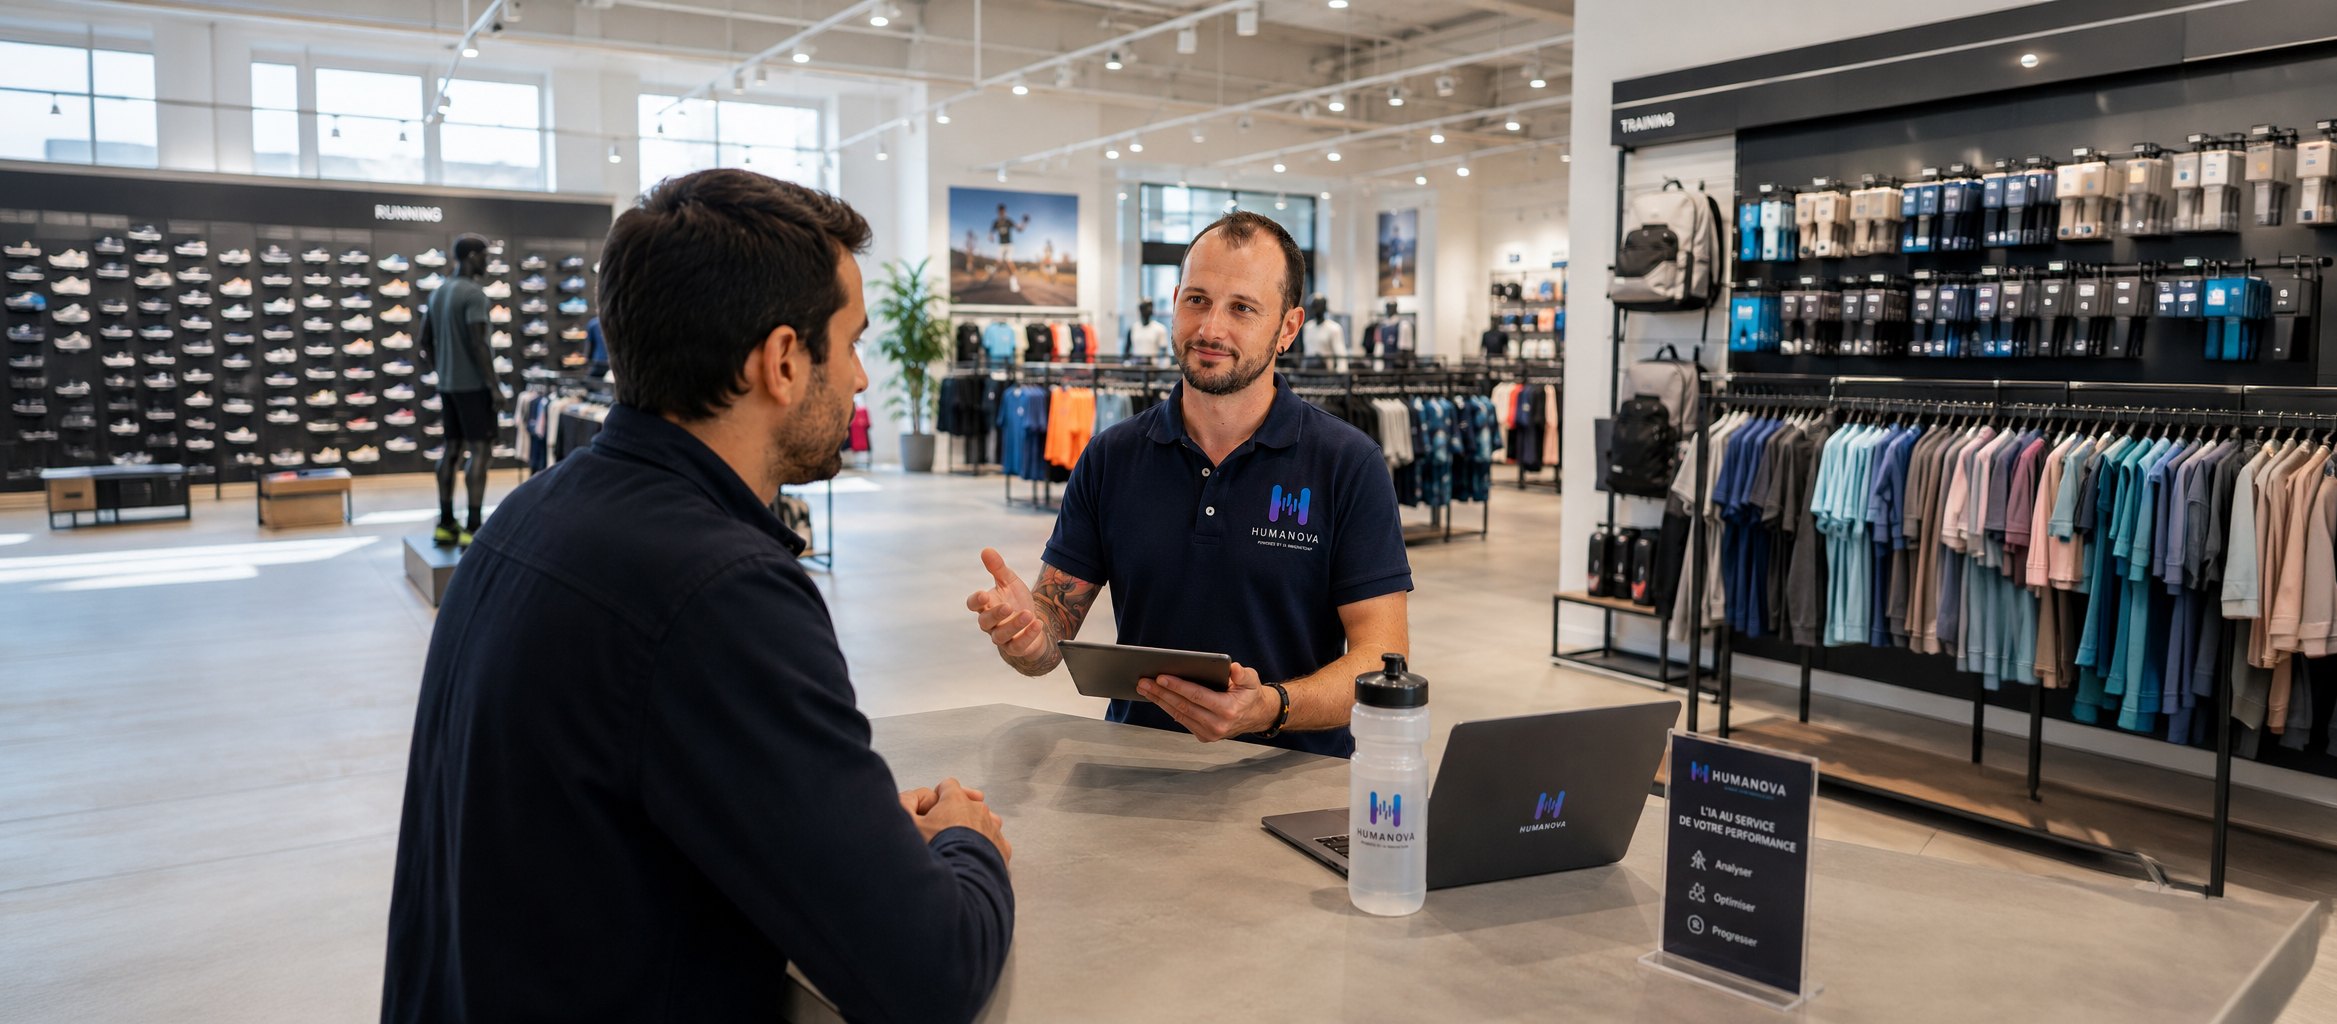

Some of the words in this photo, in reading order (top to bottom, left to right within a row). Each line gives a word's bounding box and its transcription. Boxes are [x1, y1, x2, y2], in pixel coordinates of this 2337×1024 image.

[1620, 112, 1675, 133] TRAINING
[375, 205, 442, 222] RUNNING
[1252, 527, 1319, 543] HUMANOVA
[1712, 770, 1786, 797] HUMANOVA
[1520, 821, 1566, 833] HUMANOVA
[1719, 811, 1733, 822] AU
[1735, 814, 1775, 833] SERVICE
[1357, 827, 1415, 842] HUMANOVA
[1679, 815, 1692, 827] DE
[1693, 819, 1724, 835] VOTRE
[1725, 826, 1797, 853] PERFORMANCE
[1715, 860, 1753, 878] Analyser
[1713, 893, 1756, 912] Optimiser
[1712, 925, 1758, 947] Progresser
